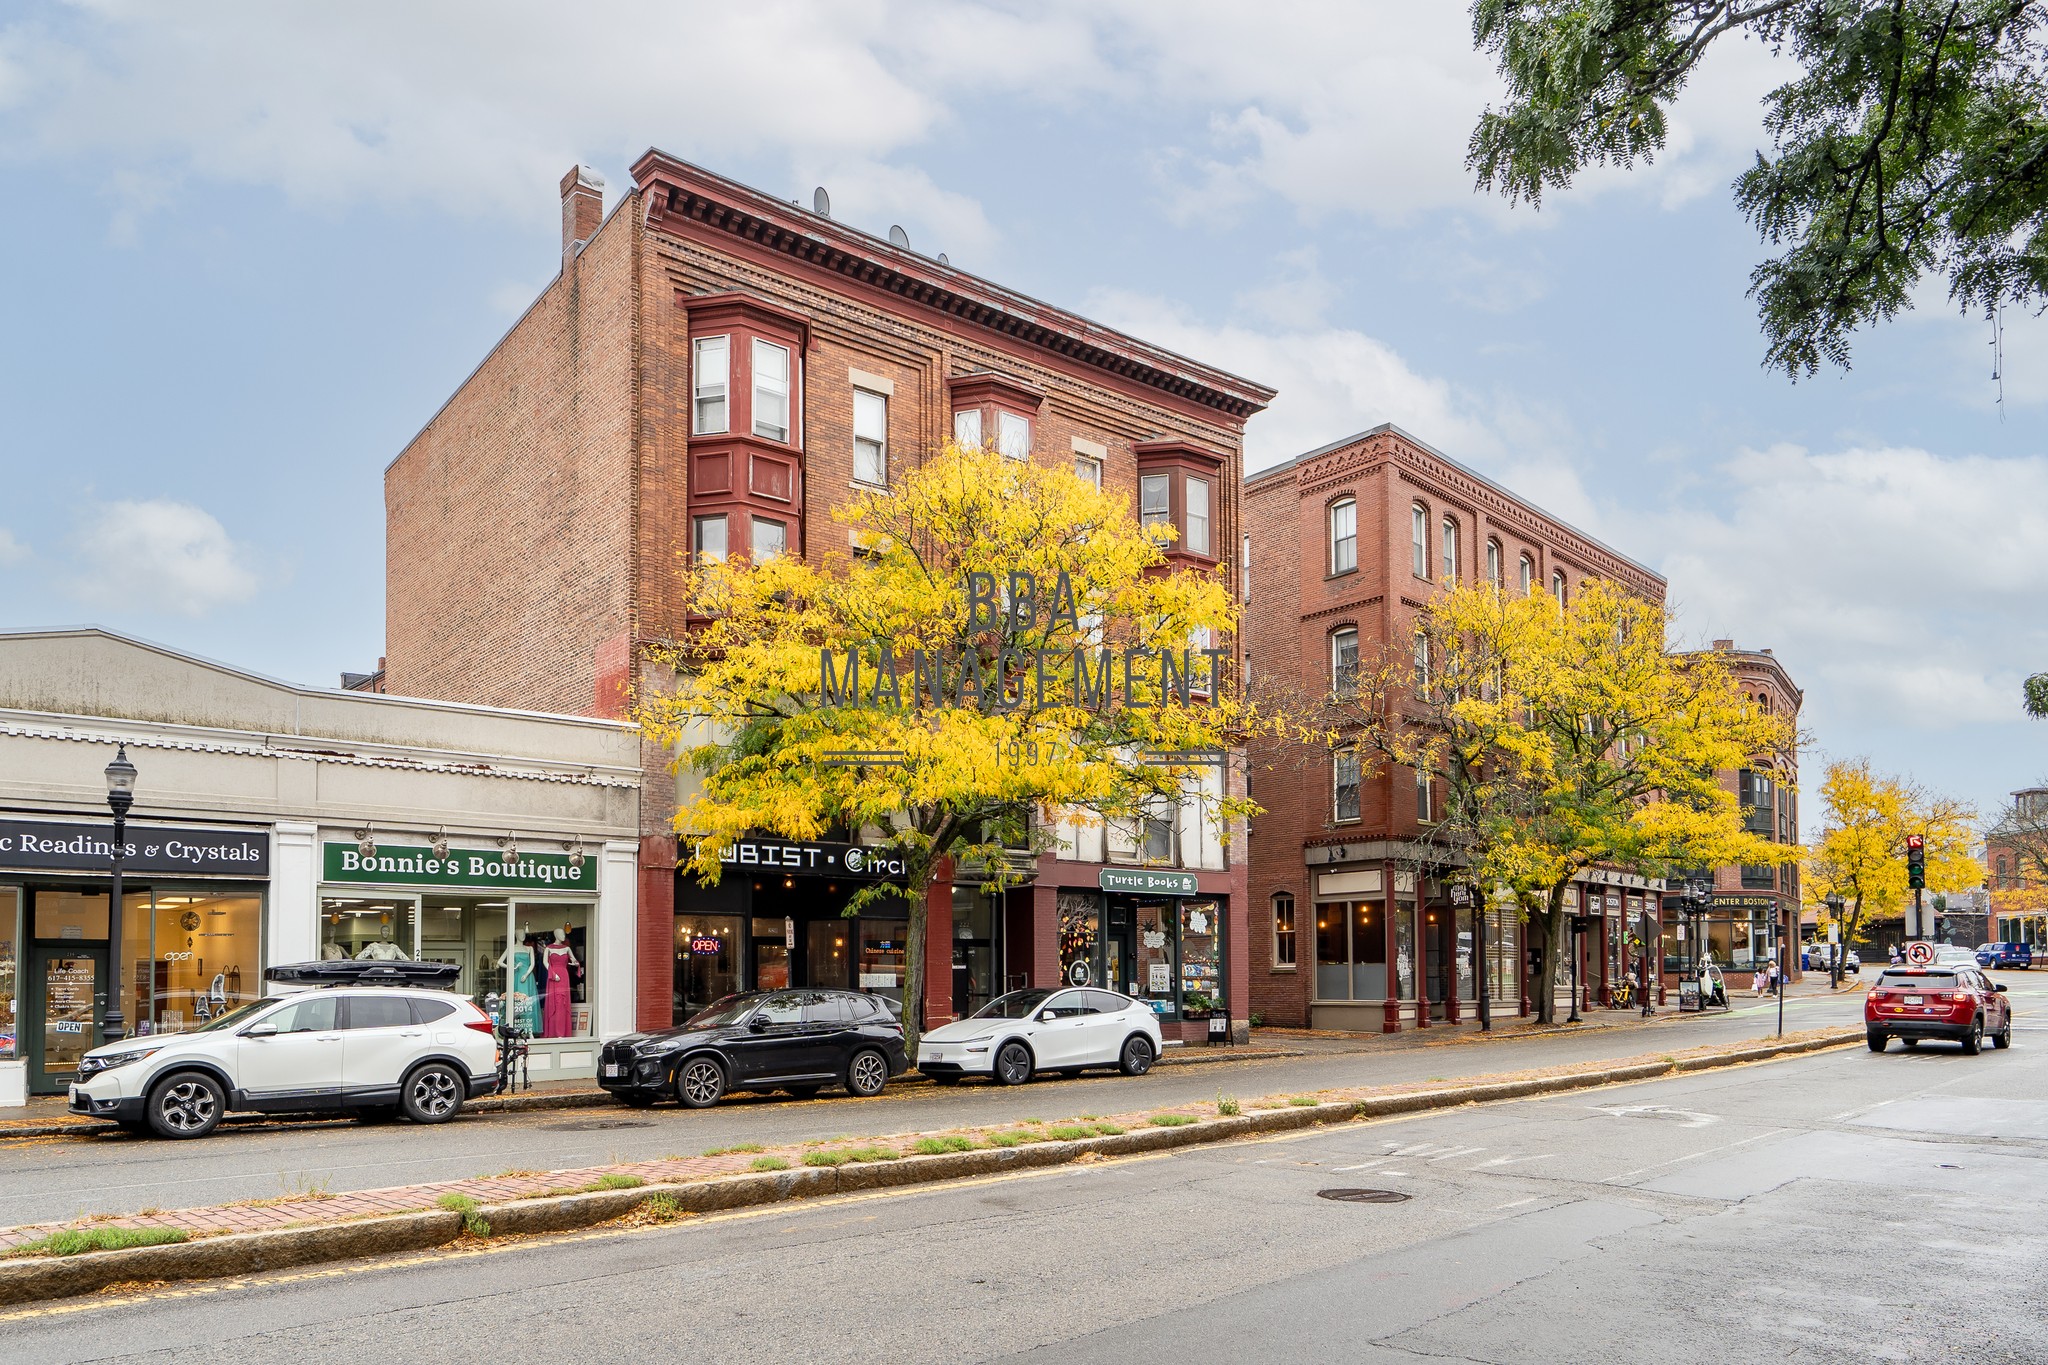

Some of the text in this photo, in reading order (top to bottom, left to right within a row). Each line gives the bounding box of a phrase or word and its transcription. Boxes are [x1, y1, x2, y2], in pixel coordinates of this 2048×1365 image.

[144, 845, 160, 857] &
[165, 840, 260, 863] Crystals
[341, 850, 582, 882] Bonnie's Boutique
[845, 847, 906, 875] Circl
[1107, 874, 1178, 888] Turtle Books
[1714, 897, 1769, 906] ENTER BOSTON
[692, 940, 718, 951] OPEN
[164, 951, 194, 967] open
[58, 1022, 81, 1031] OPEN
